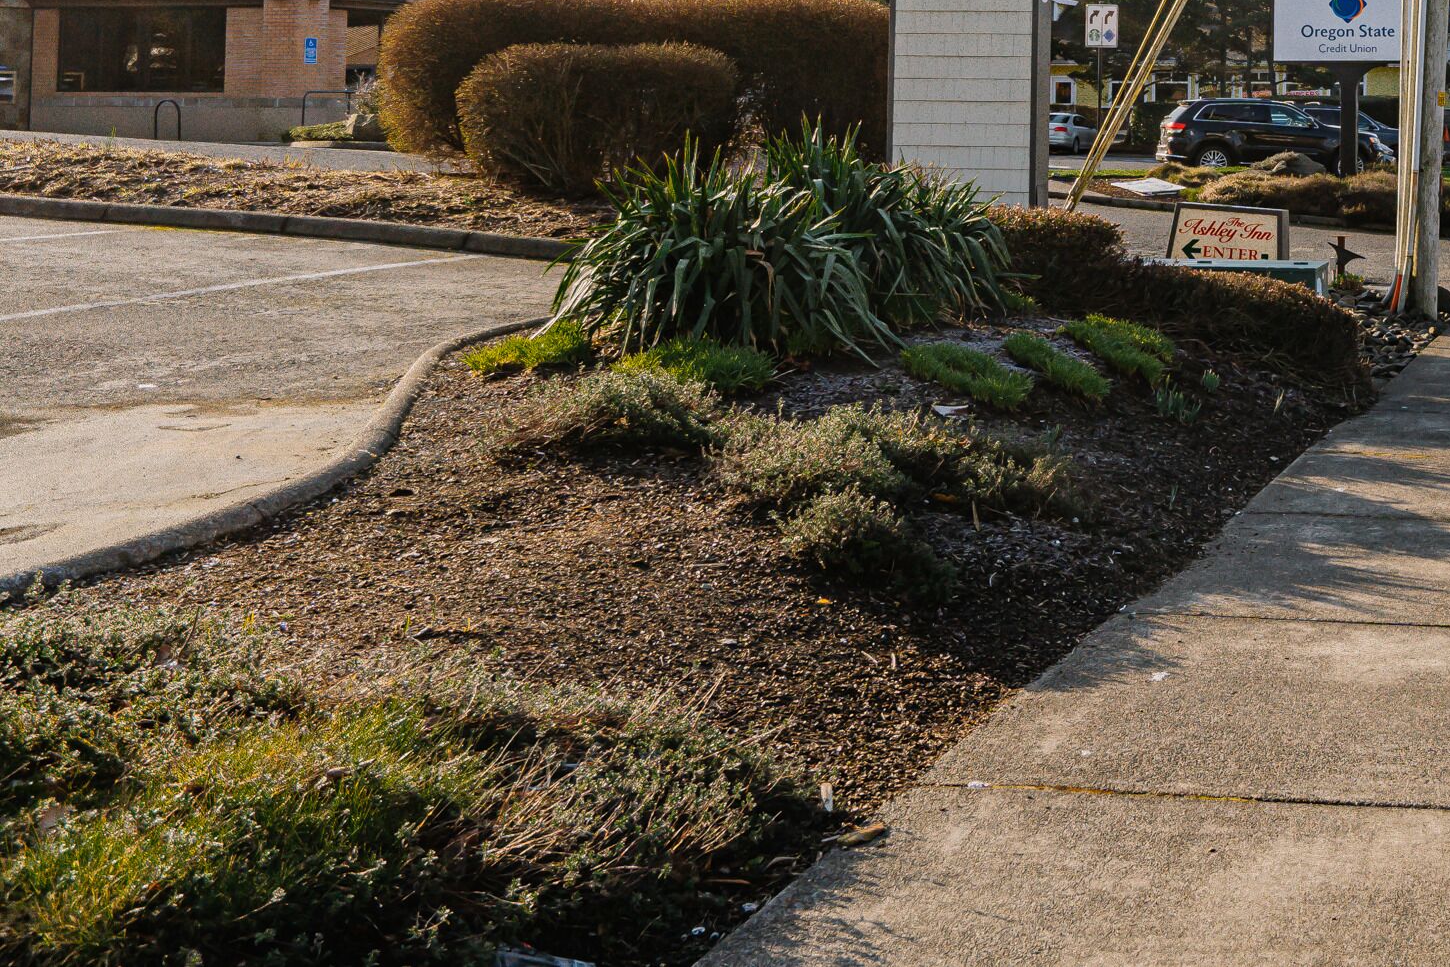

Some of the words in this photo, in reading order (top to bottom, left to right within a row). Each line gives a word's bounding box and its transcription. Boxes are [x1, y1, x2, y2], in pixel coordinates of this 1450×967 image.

[1301, 24, 1355, 41] Oregon
[1359, 24, 1395, 38] State
[1318, 44, 1347, 53] Credit
[1349, 44, 1378, 53] Union
[1226, 217, 1244, 228] The
[1178, 218, 1237, 243] Ashley
[1239, 223, 1274, 241] Inn
[1202, 245, 1258, 260] ENTER
